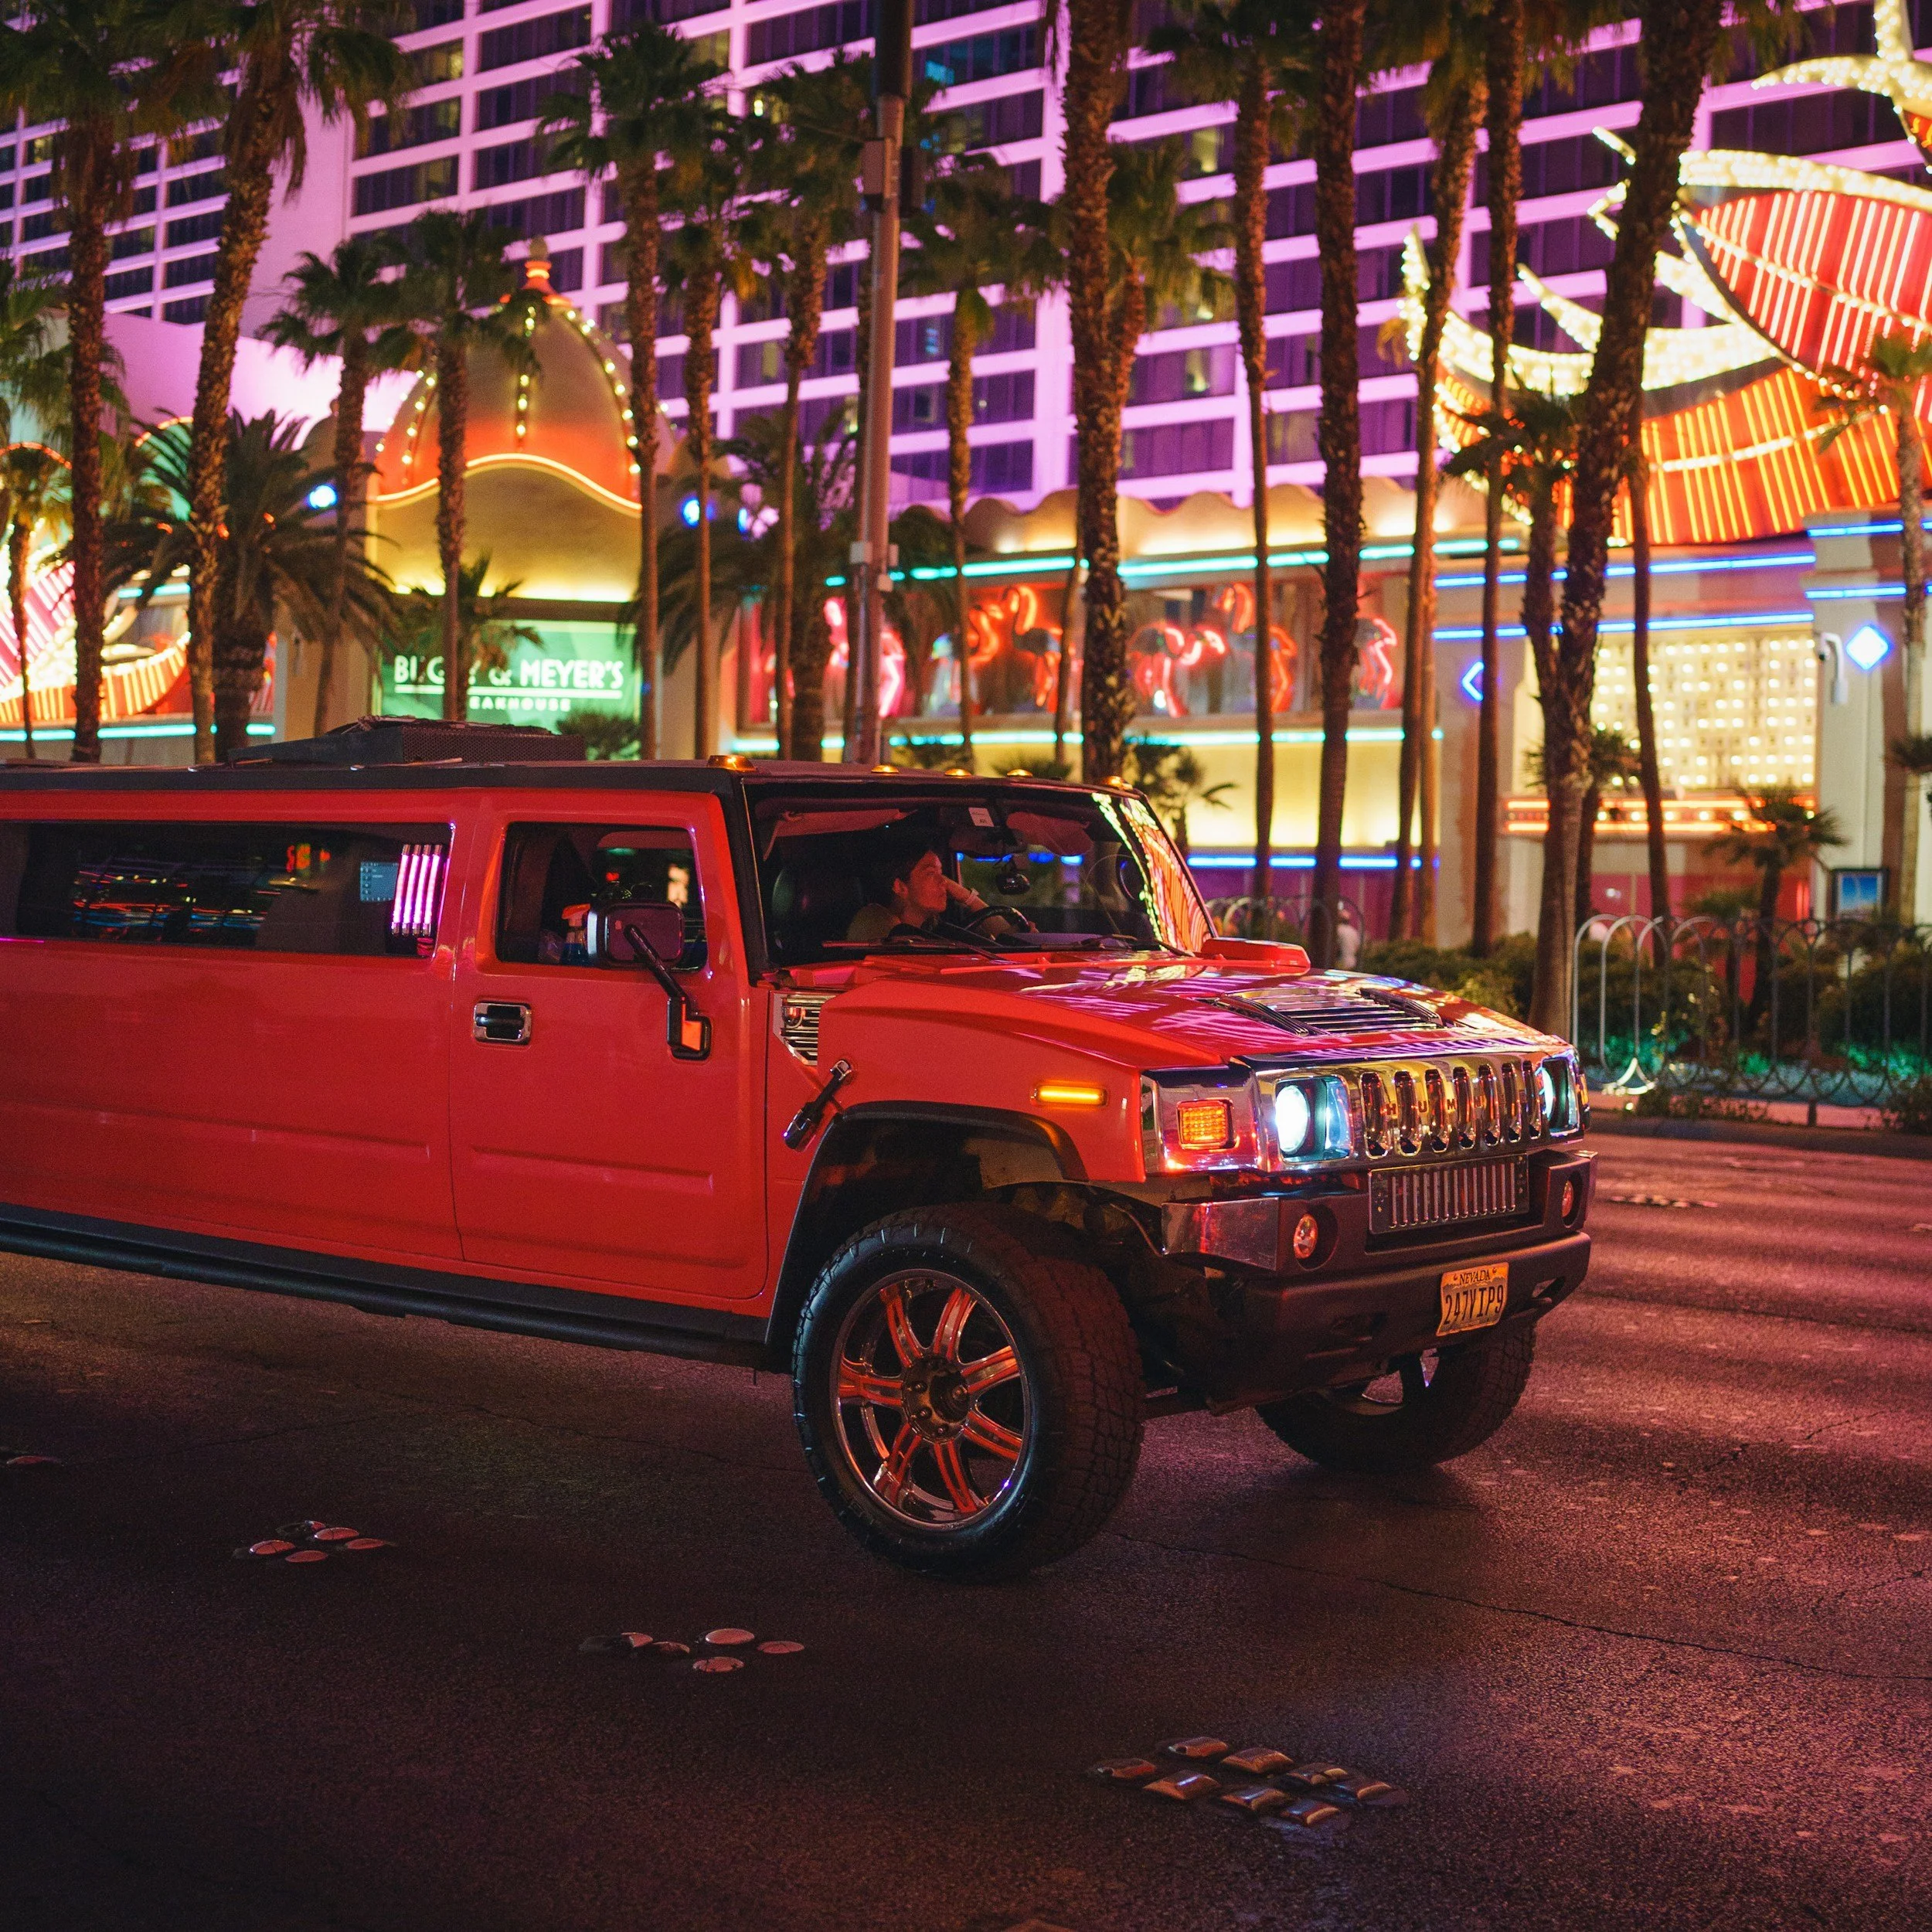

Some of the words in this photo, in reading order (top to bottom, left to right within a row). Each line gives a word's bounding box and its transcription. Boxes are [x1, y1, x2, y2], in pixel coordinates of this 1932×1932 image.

[488, 665, 513, 686] &
[519, 658, 624, 689] MEYER'S
[469, 696, 571, 712] EAKHOUSE
[1386, 1090, 1528, 1116] HUMM
[1458, 1269, 1491, 1285] NEVADA
[1443, 1284, 1504, 1325] 247VIP9
